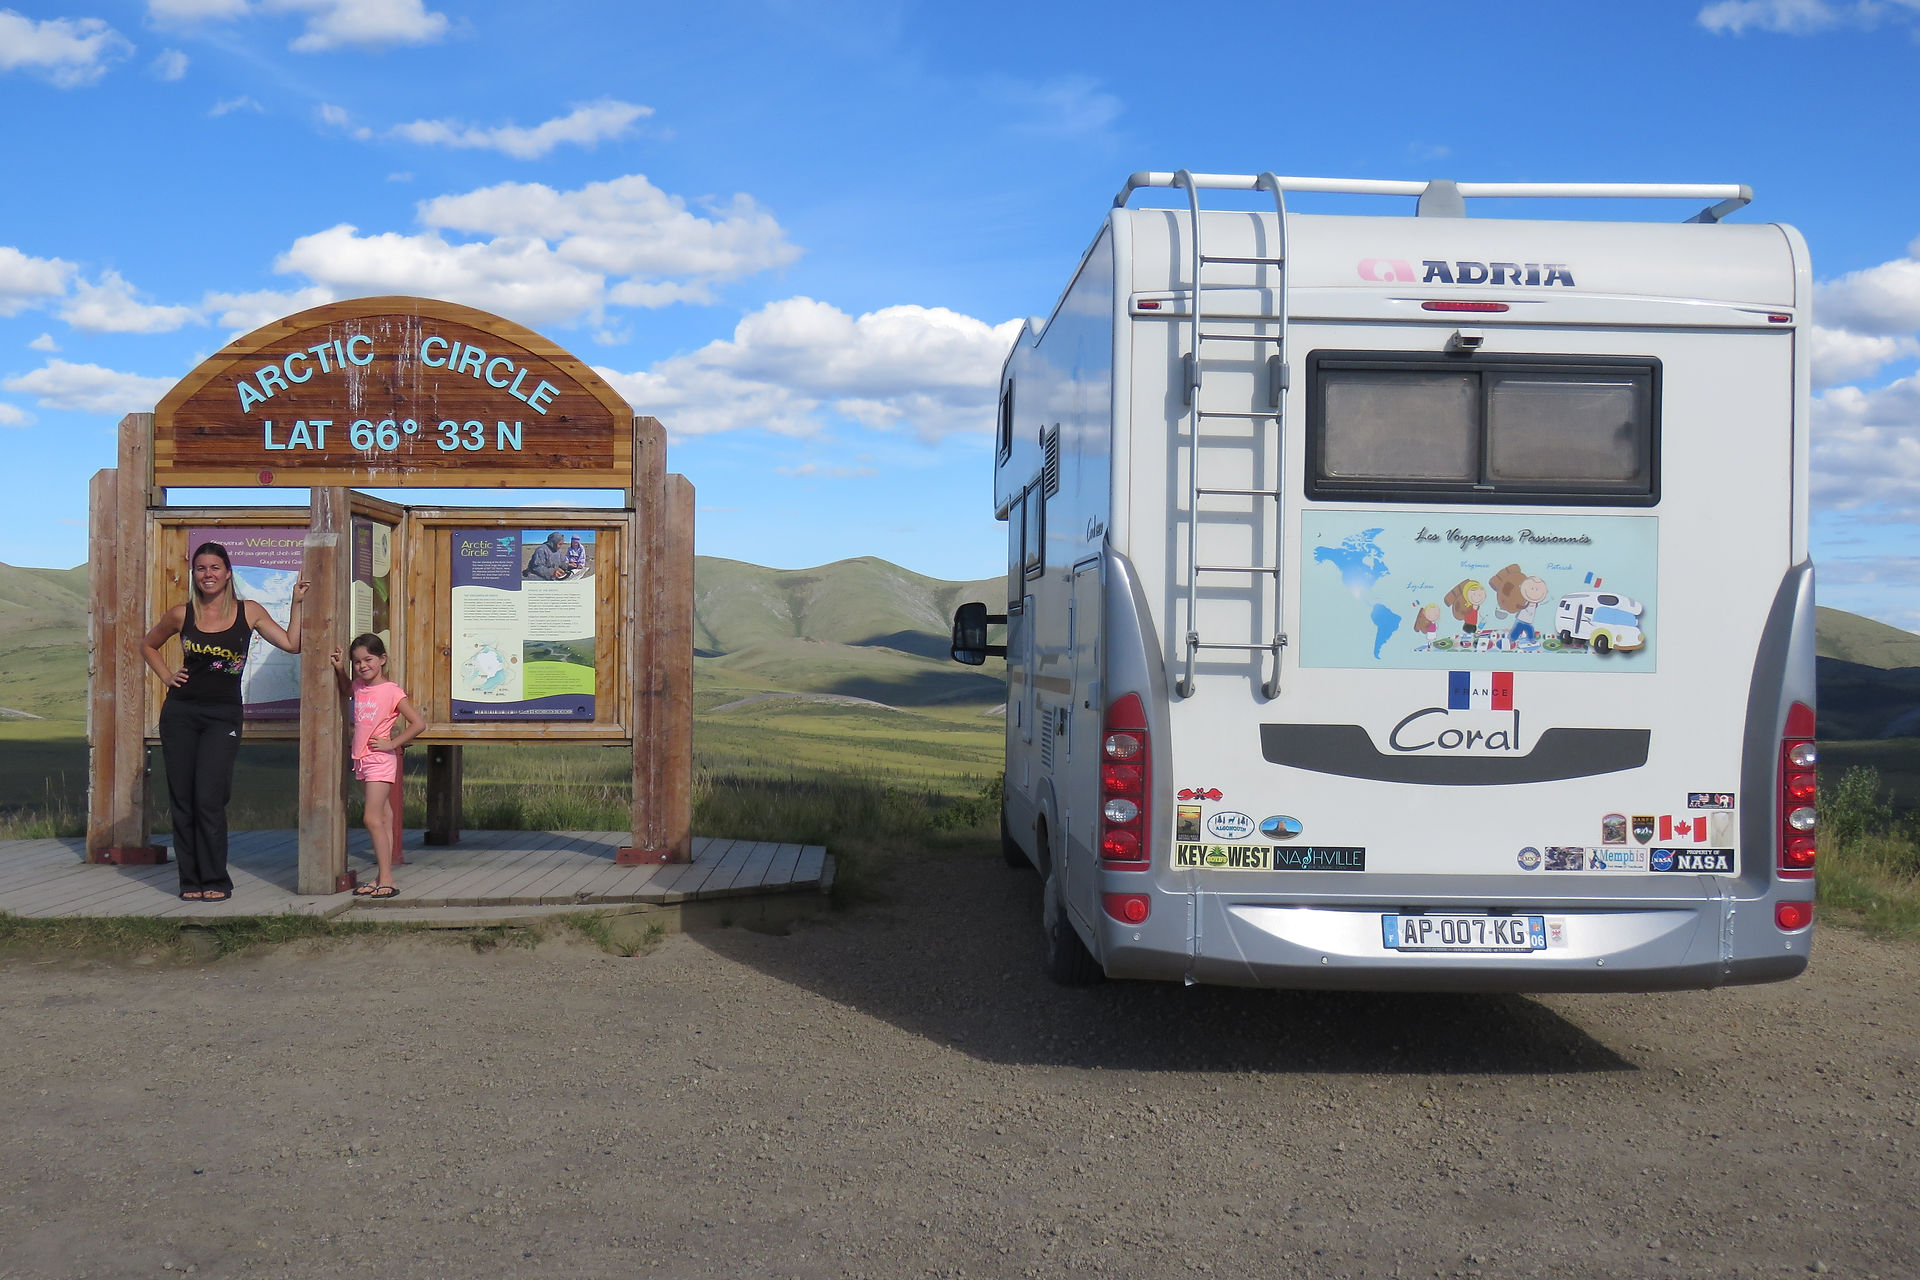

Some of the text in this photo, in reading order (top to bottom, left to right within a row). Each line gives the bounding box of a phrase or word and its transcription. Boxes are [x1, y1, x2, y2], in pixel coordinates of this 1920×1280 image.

[1422, 260, 1576, 287] ADRIA
[236, 334, 561, 415] ARCTIC CIRCLE
[264, 418, 522, 451] LAT 66° 33 N
[461, 540, 493, 549] Arctic
[1414, 526, 1592, 550] Les Voyageurs Passionnés
[461, 548, 489, 557] Circle
[1453, 688, 1508, 697] FRANCE
[1389, 707, 1520, 752] Coral
[1177, 844, 1270, 868] KEY WEST
[1277, 847, 1362, 869] NASHVILLE
[1600, 849, 1645, 865] Memphis
[1677, 855, 1728, 869] NASA
[1404, 919, 1525, 945] AP-007-KG
[1531, 934, 1544, 947] 06
